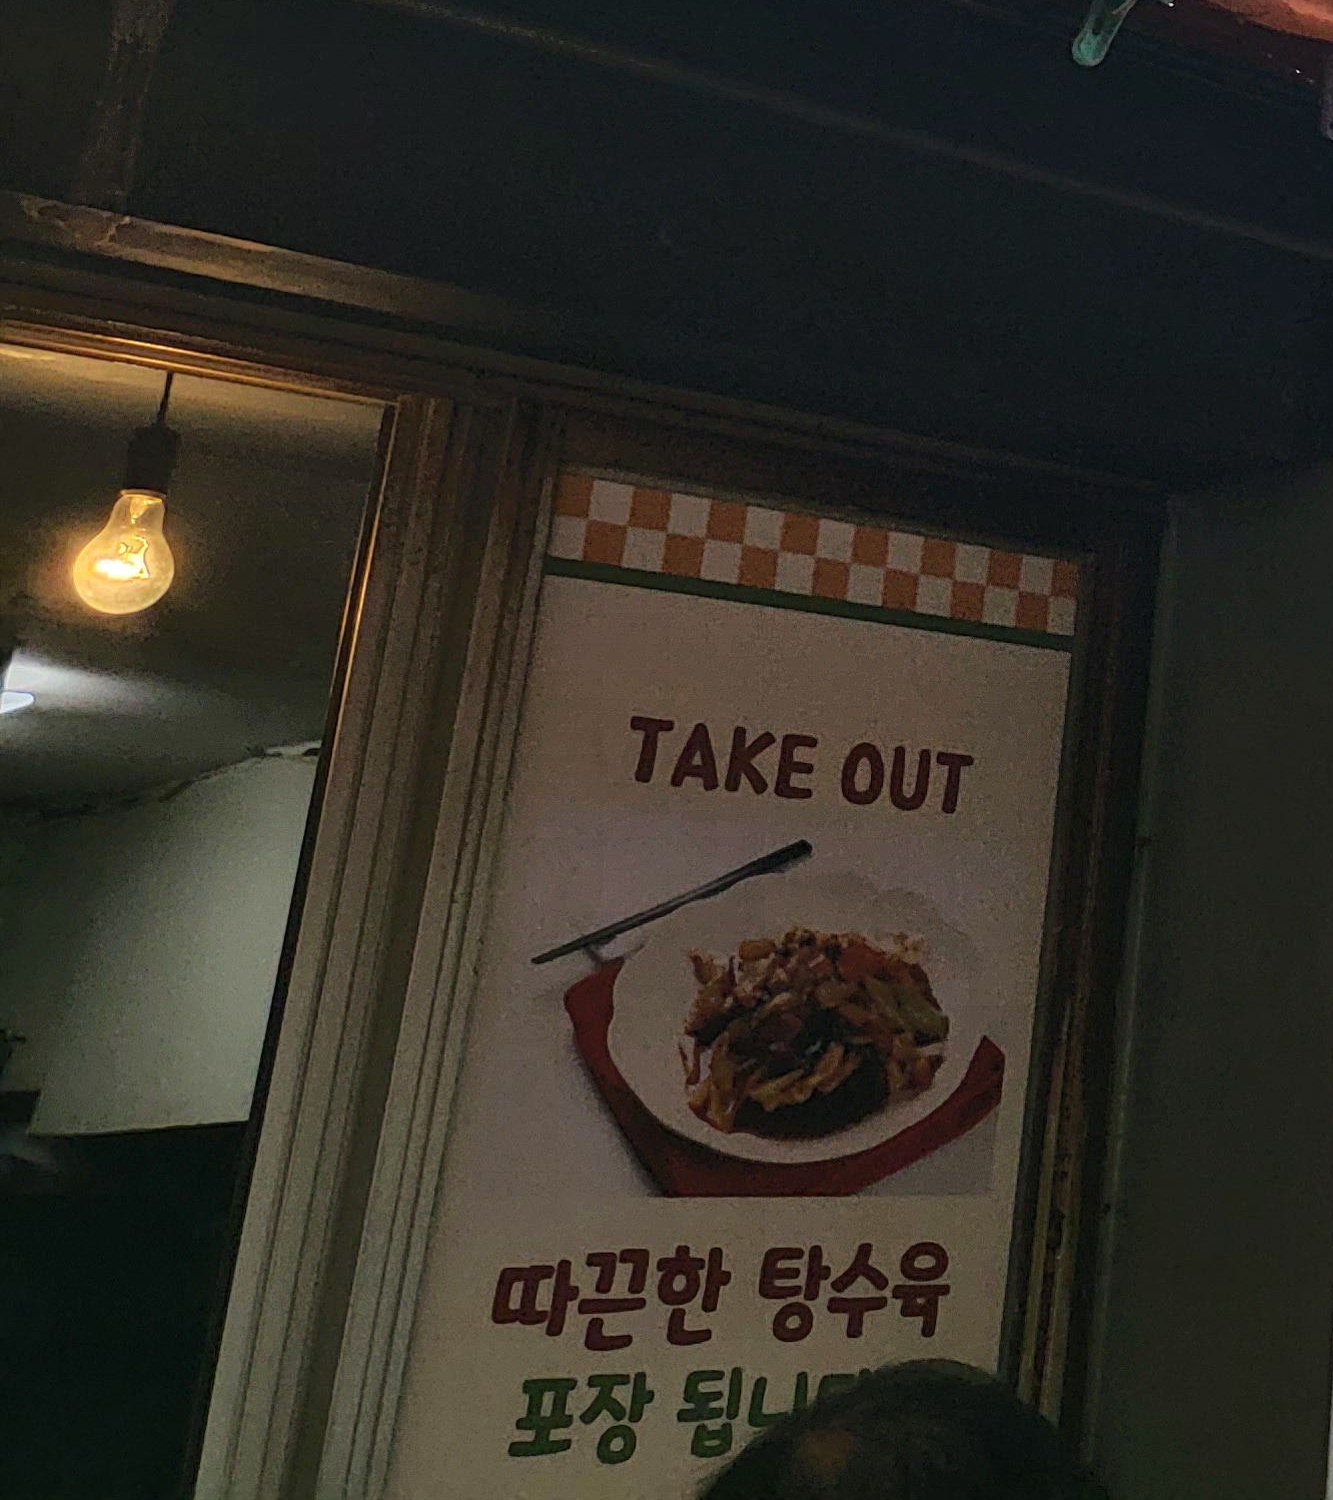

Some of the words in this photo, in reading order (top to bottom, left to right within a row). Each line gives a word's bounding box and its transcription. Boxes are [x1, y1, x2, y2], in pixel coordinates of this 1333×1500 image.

[629, 715, 818, 800] TAKE
[840, 741, 973, 813] OUT
[490, 1245, 731, 1351] 따끈한
[758, 1241, 951, 1340] 탕수육
[508, 1370, 654, 1464] 포장
